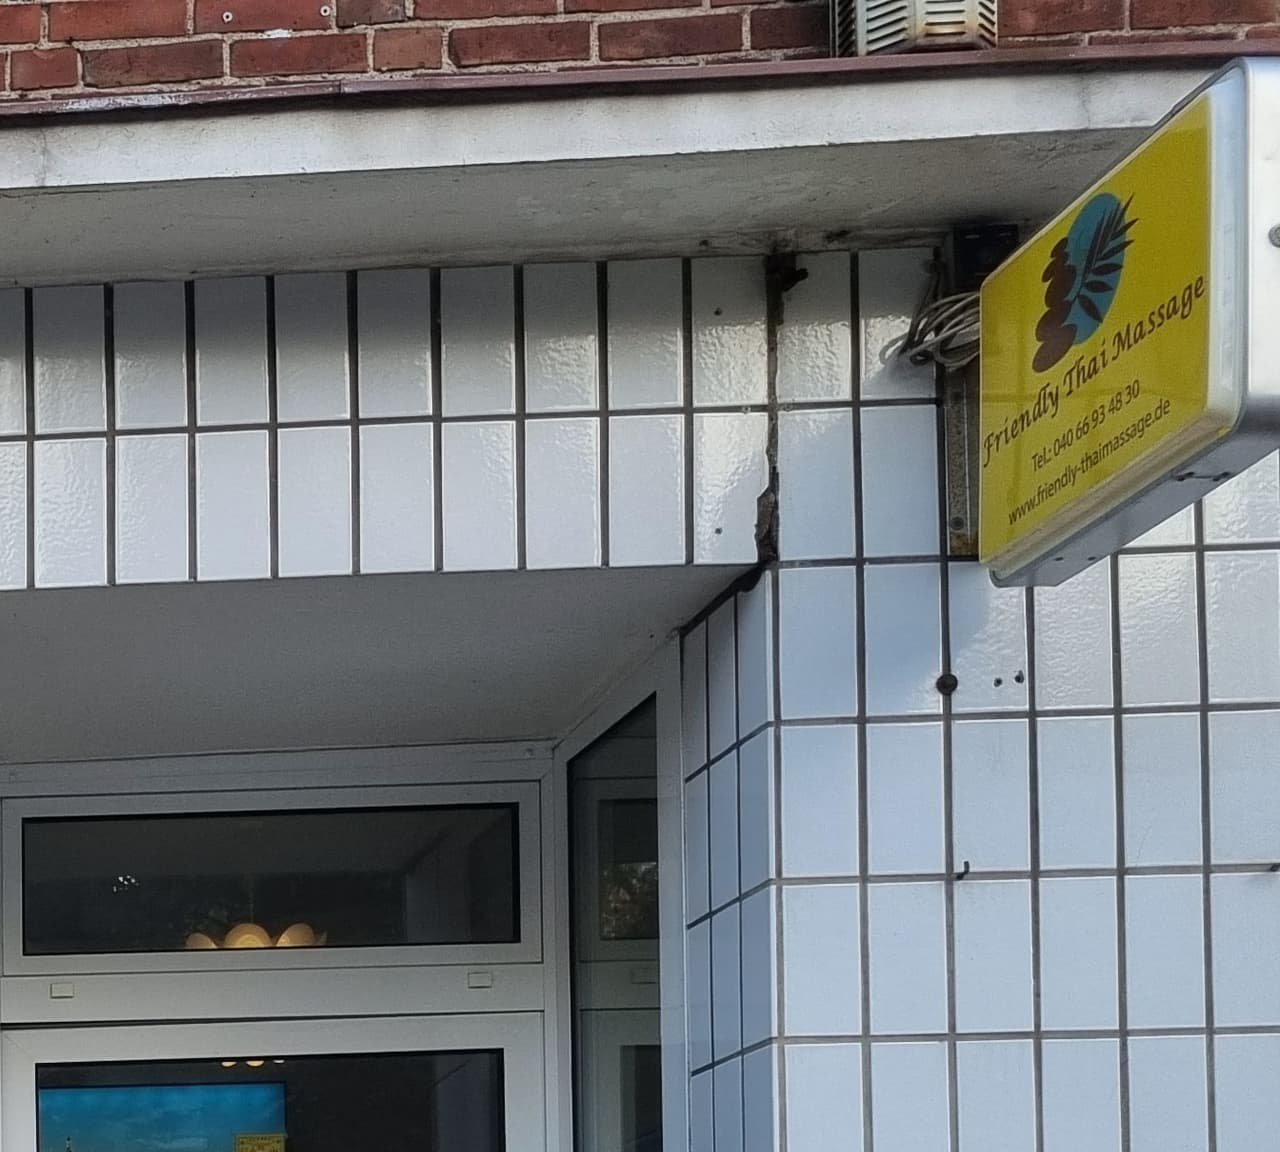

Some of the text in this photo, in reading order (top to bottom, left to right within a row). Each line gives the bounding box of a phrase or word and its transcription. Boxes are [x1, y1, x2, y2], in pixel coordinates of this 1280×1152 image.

[983, 276, 1205, 468] Friendly Thai Massage
[1032, 380, 1140, 472] Tel.: 040 66 93 48 30
[1008, 399, 1170, 525] www.friendly-thaimassage.de
